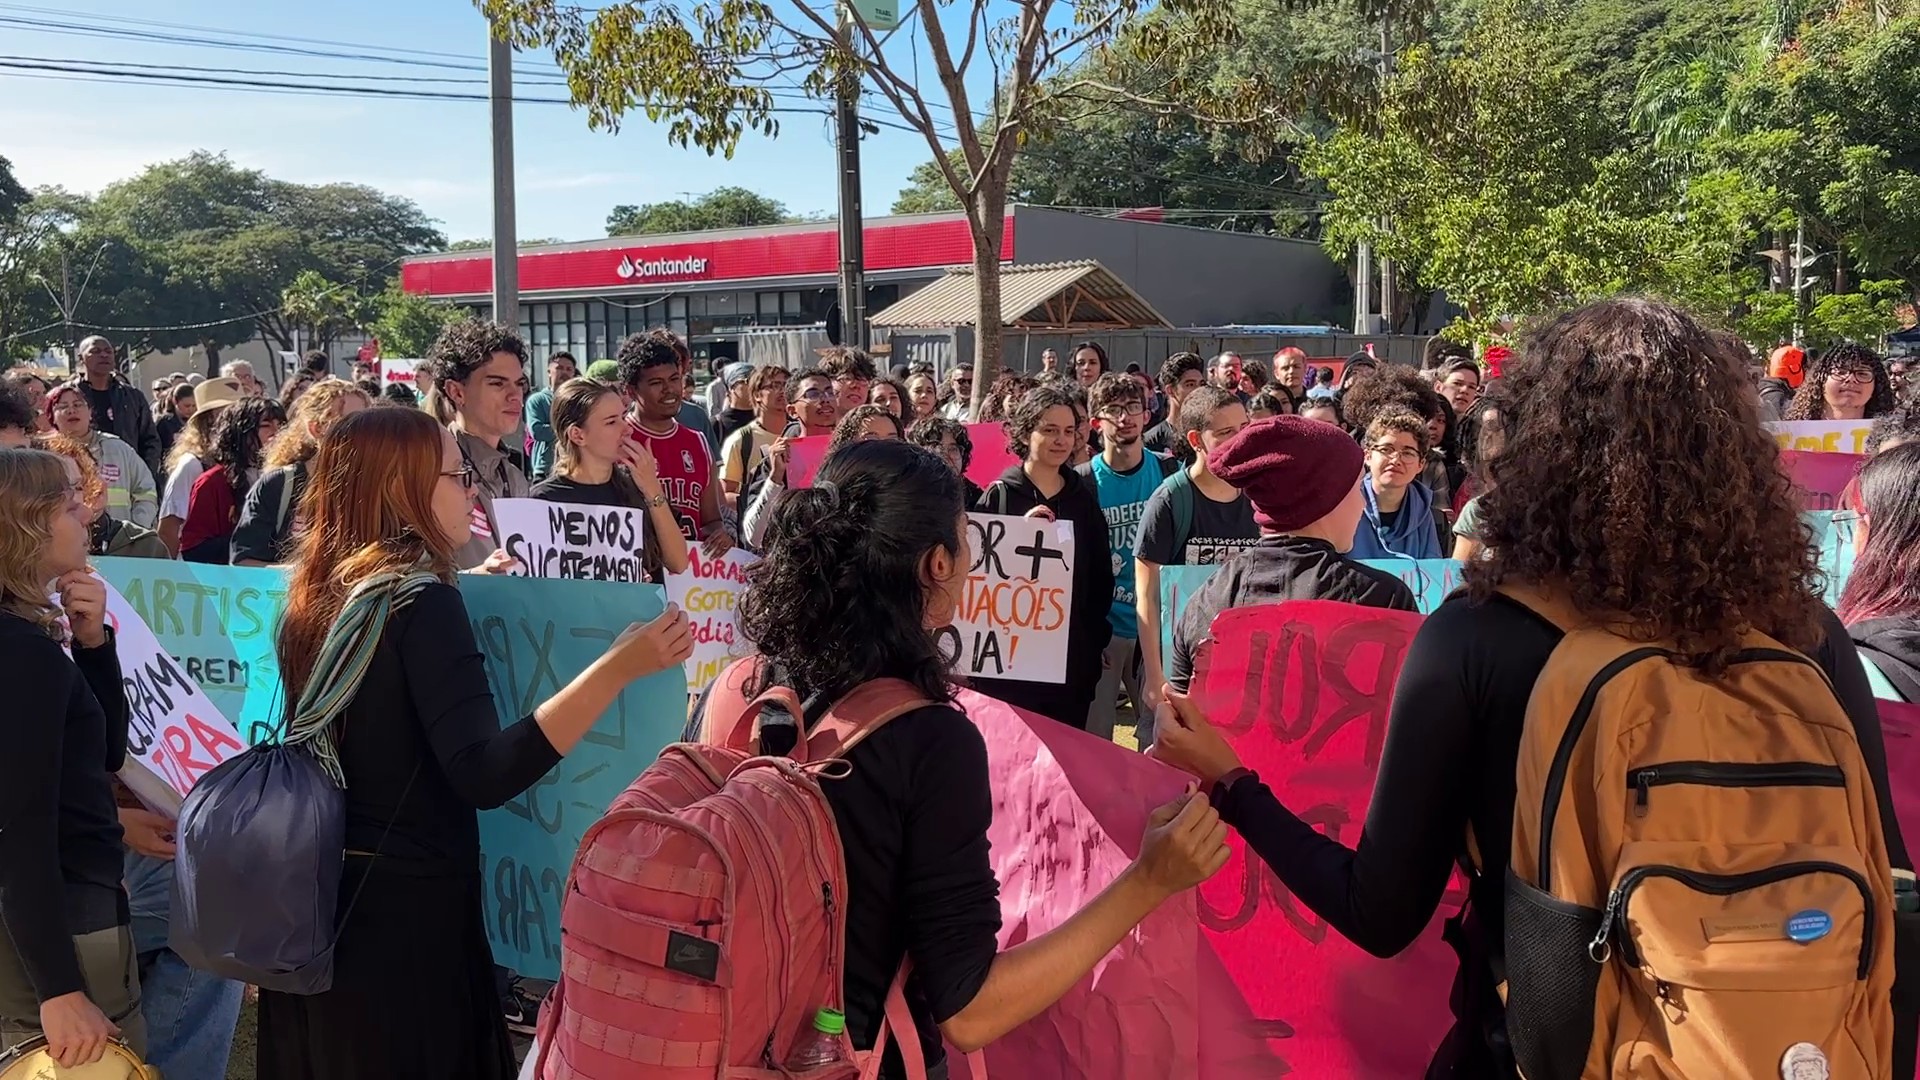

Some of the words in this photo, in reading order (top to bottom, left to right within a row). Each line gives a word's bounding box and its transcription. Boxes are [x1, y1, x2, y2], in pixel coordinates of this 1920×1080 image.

[635, 255, 707, 277] Santander
[548, 506, 635, 551] MENOS
[170, 655, 250, 688] REM
